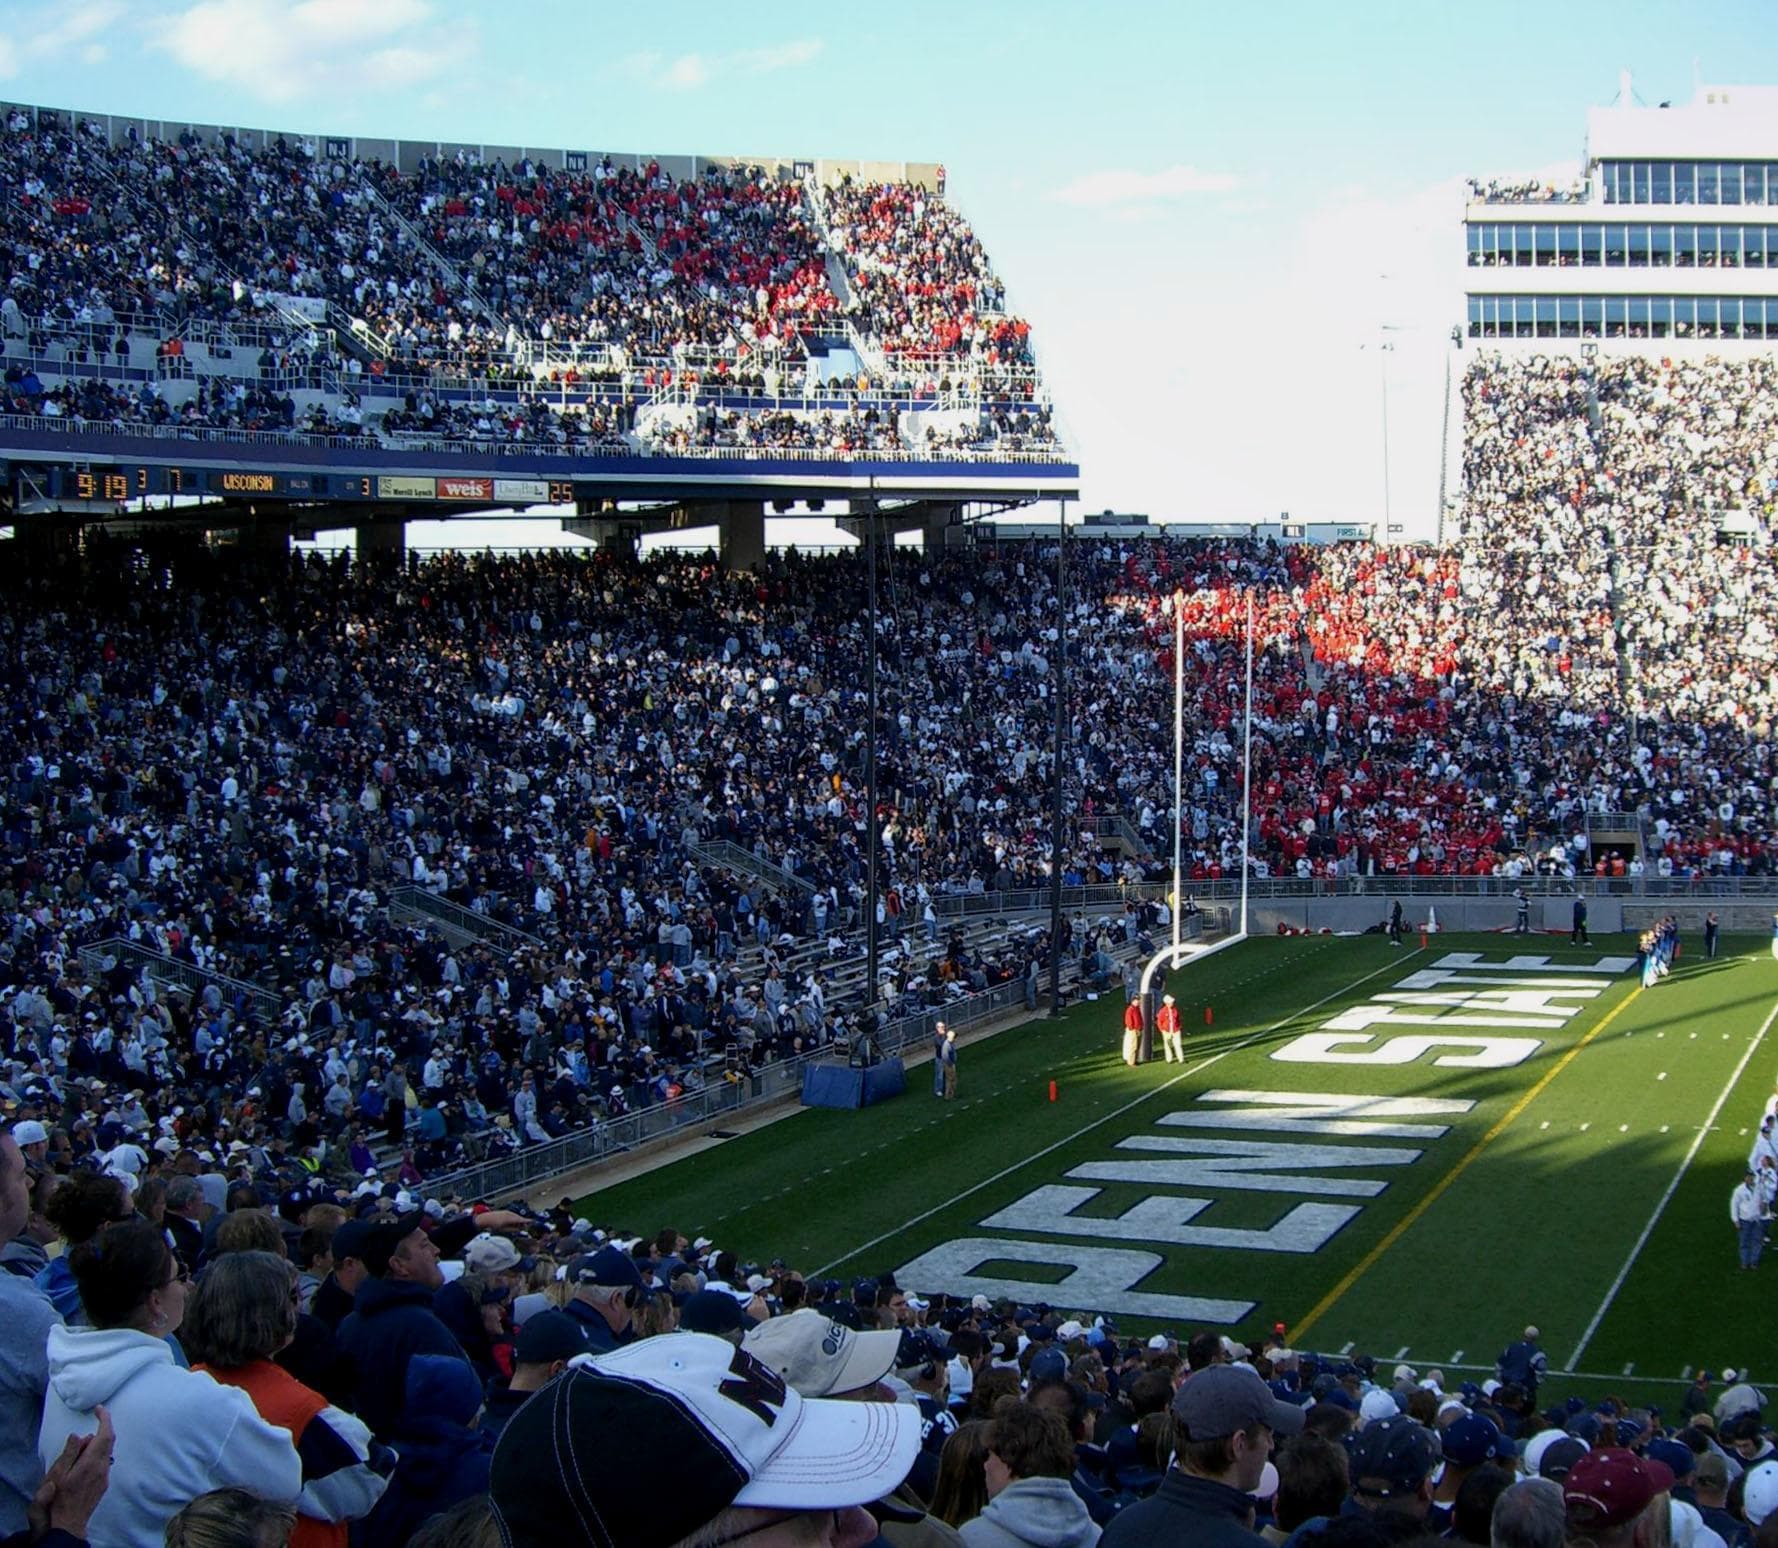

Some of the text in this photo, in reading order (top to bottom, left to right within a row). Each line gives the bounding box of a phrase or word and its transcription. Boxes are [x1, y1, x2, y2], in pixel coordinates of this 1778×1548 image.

[329, 143, 347, 155] NJ
[569, 156, 585, 169] NK
[78, 473, 127, 499] 9:19
[138, 470, 147, 489] 3
[170, 469, 181, 491] 7
[222, 474, 273, 491] WISCONSIN
[361, 478, 370, 495] 3
[446, 480, 485, 498] weis
[550, 482, 573, 503] 25
[1269, 951, 1640, 1069] STATE
[894, 1090, 1477, 1324] PENN
